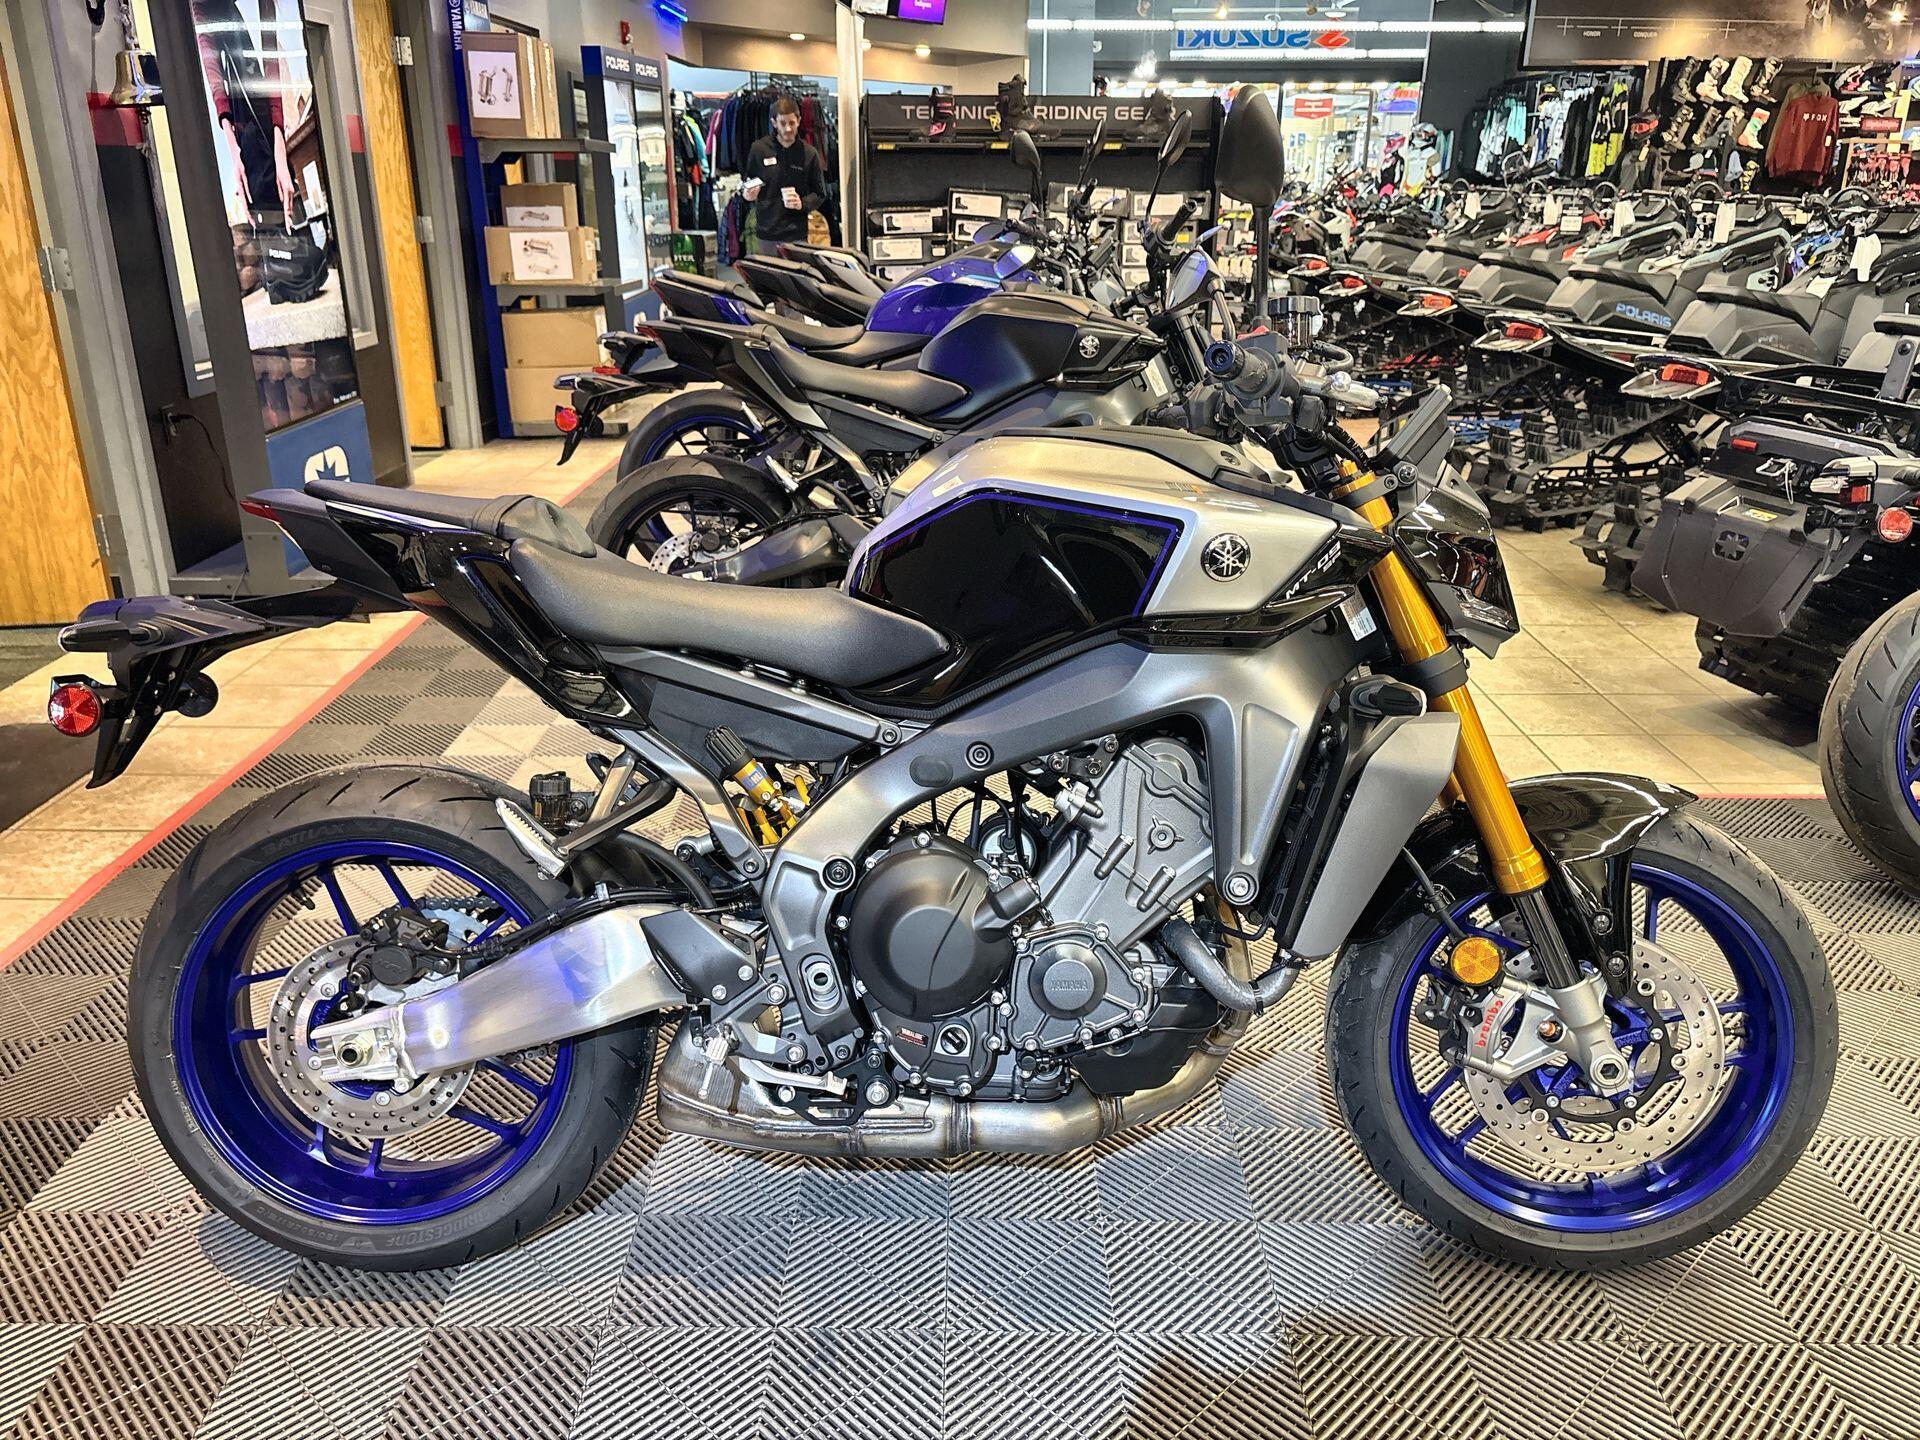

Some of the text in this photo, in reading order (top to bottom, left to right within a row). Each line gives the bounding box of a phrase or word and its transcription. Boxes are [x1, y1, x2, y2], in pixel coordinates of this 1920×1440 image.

[451, 8, 463, 50] YAMAHA
[605, 56, 630, 72] POLARIS
[635, 63, 659, 78] POLARIS
[1033, 105, 1107, 121] RIDING
[1811, 113, 1828, 122] FOX
[1615, 302, 1672, 328] POLARIS
[1285, 540, 1341, 600] MT-09
[1050, 979, 1088, 991] YAMAHA
[1474, 1000, 1503, 1047] brembo
[385, 1206, 490, 1248] BRIDGESTONE
